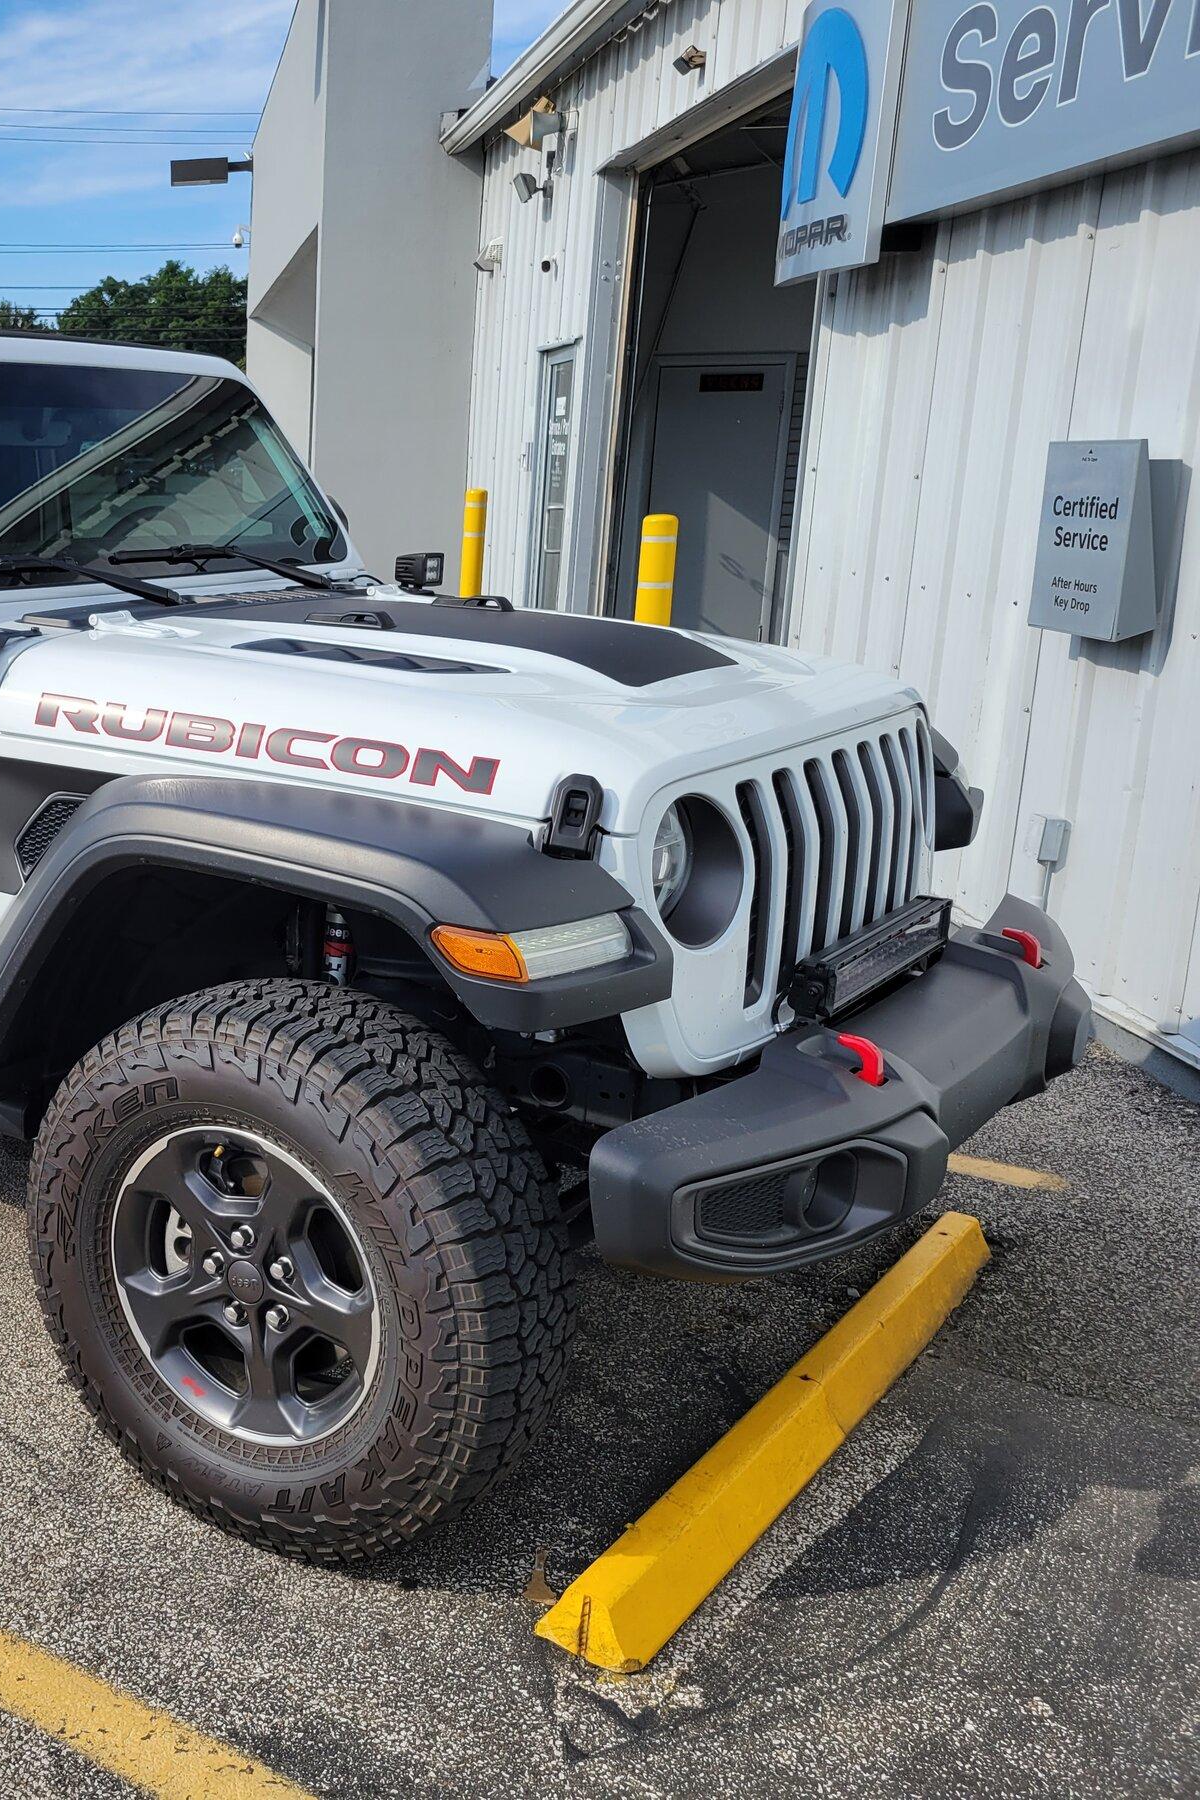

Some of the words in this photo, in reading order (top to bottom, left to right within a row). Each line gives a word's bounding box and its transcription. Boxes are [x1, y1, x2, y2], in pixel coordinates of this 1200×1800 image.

[933, 0, 1200, 152] Serv
[1053, 495, 1119, 520] Certified
[1053, 526, 1109, 551] Service
[1051, 576, 1072, 590] After
[1073, 579, 1098, 594] Hours
[1053, 594, 1069, 611] Key
[1070, 597, 1090, 614] Drop
[34, 691, 500, 796] RUBICON
[56, 1075, 180, 1264] FALKEN
[332, 1171, 424, 1492] WILDPEAK
